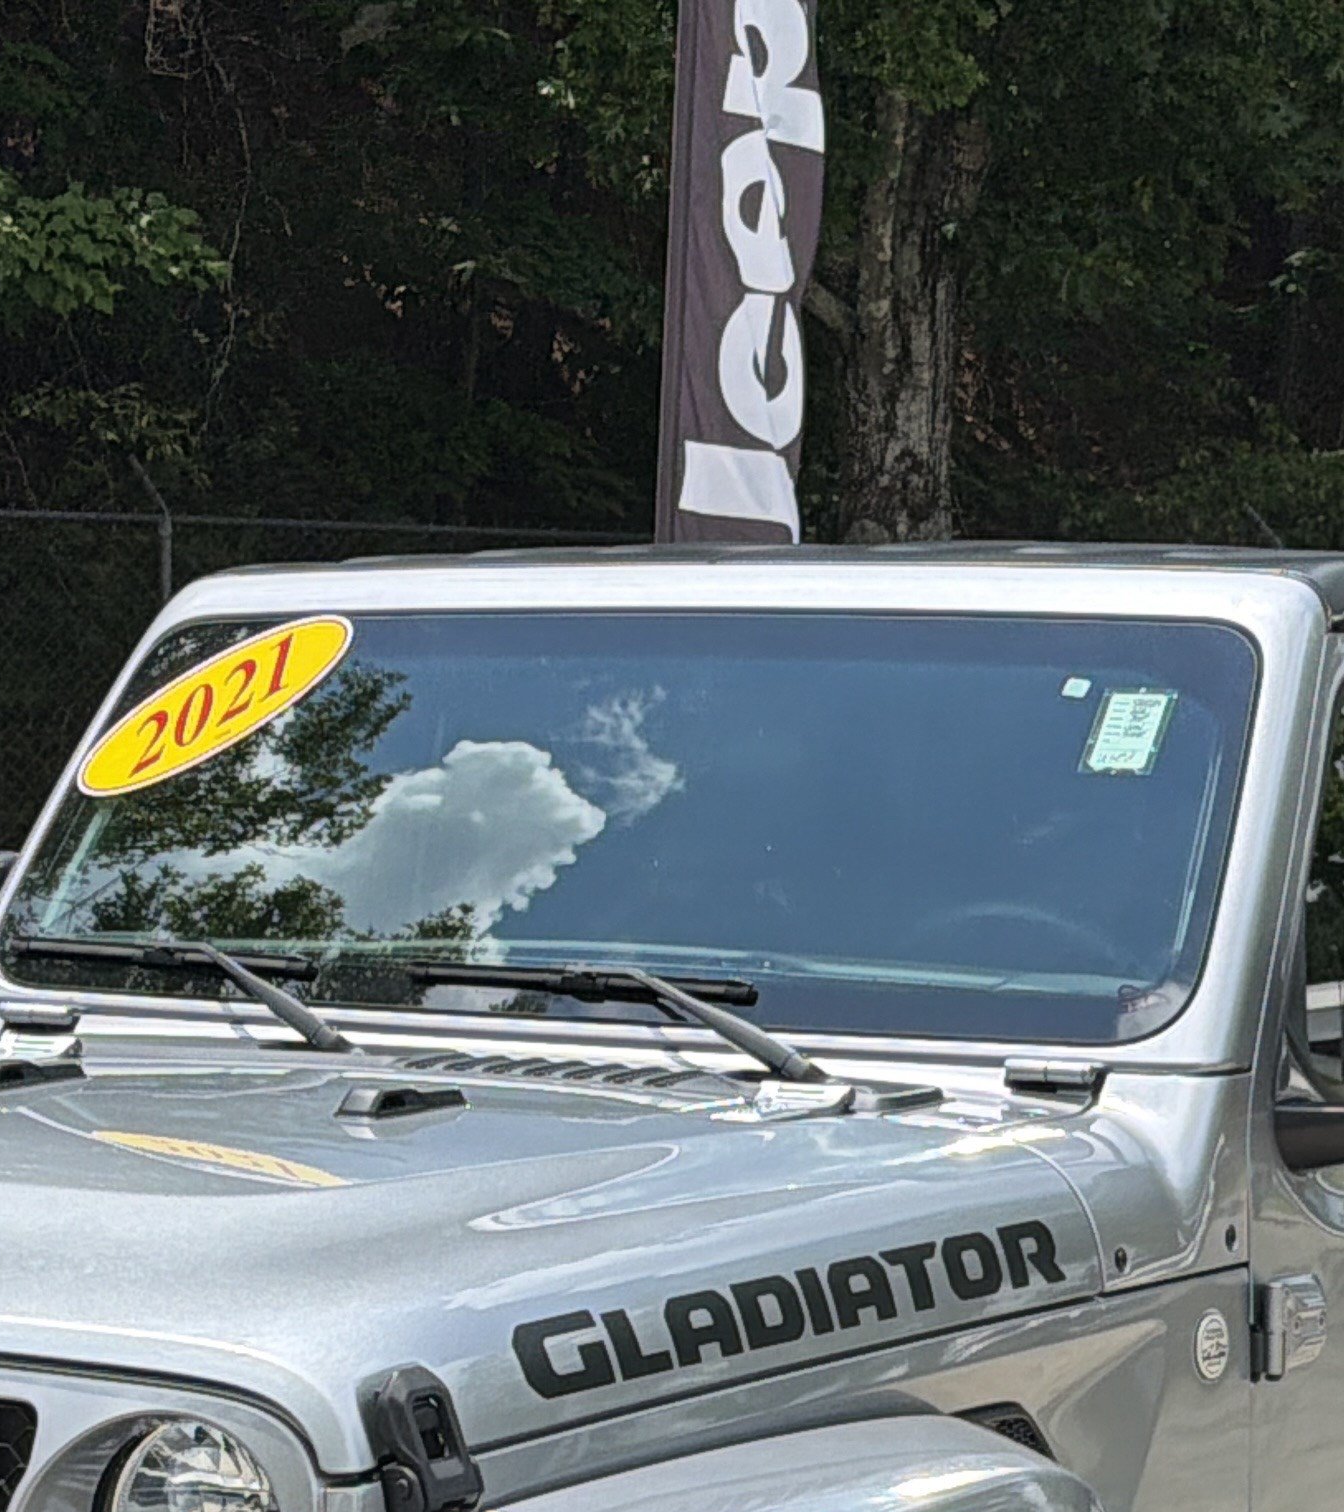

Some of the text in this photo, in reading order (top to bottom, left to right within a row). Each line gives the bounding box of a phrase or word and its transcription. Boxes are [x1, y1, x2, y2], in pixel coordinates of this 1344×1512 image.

[678, 0, 825, 545] Jeep
[127, 632, 294, 779] 2021
[511, 1219, 1067, 1400] GLADIATOR
